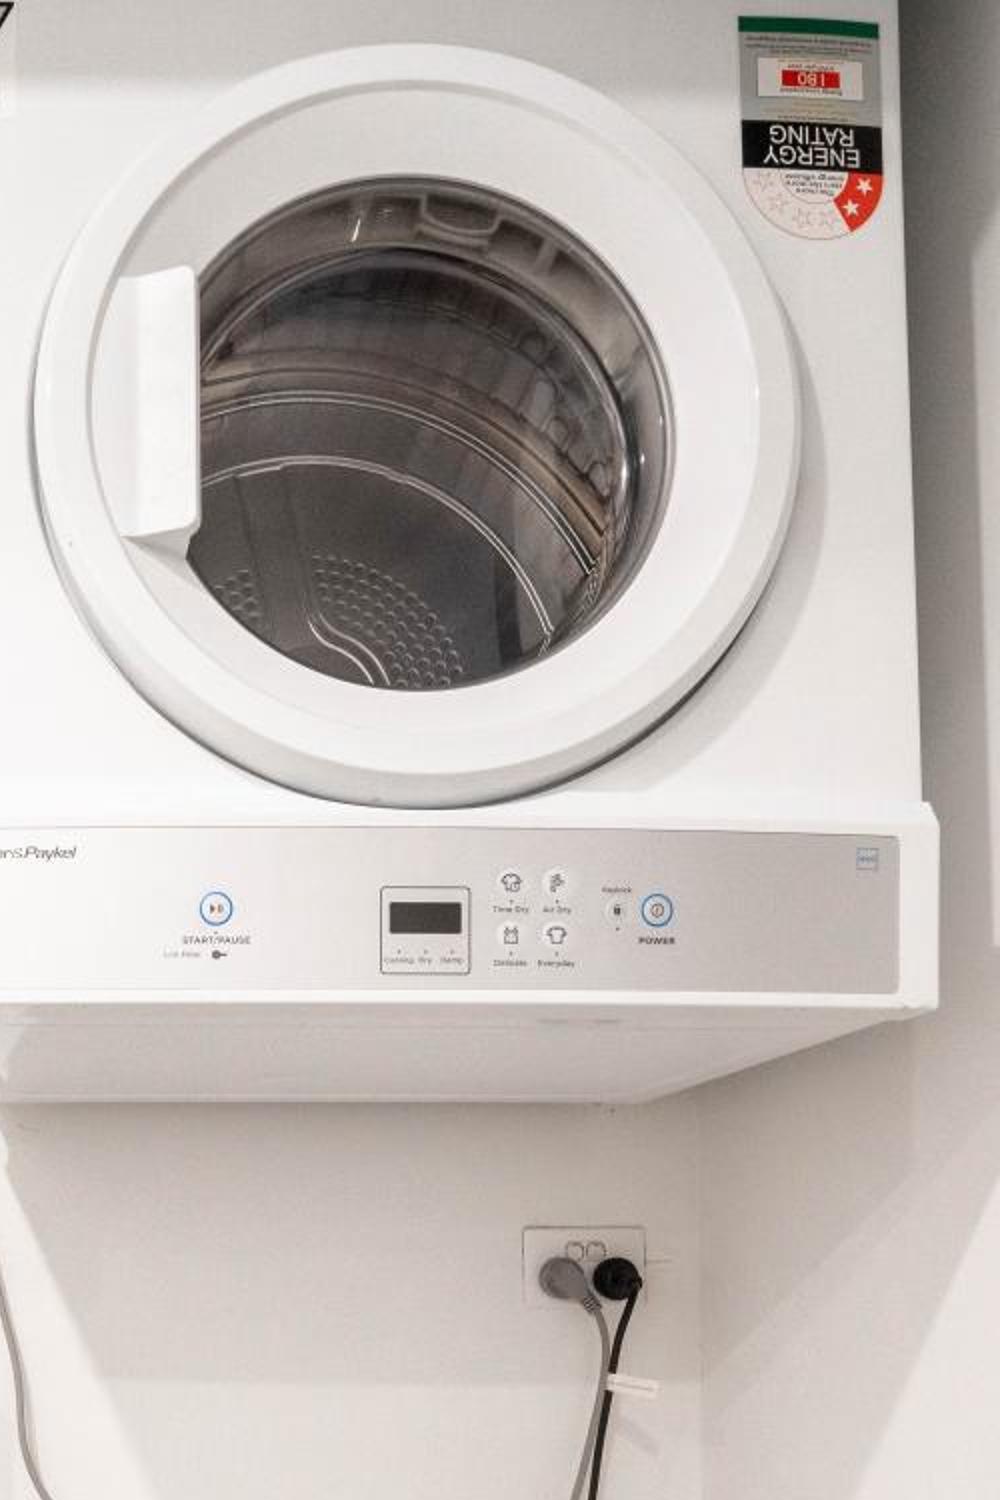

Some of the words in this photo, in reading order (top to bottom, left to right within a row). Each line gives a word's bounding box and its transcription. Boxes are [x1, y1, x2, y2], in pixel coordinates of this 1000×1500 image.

[769, 124, 854, 147] RATING
[763, 145, 860, 168] ENERGY
[638, 937, 675, 945] POWER
